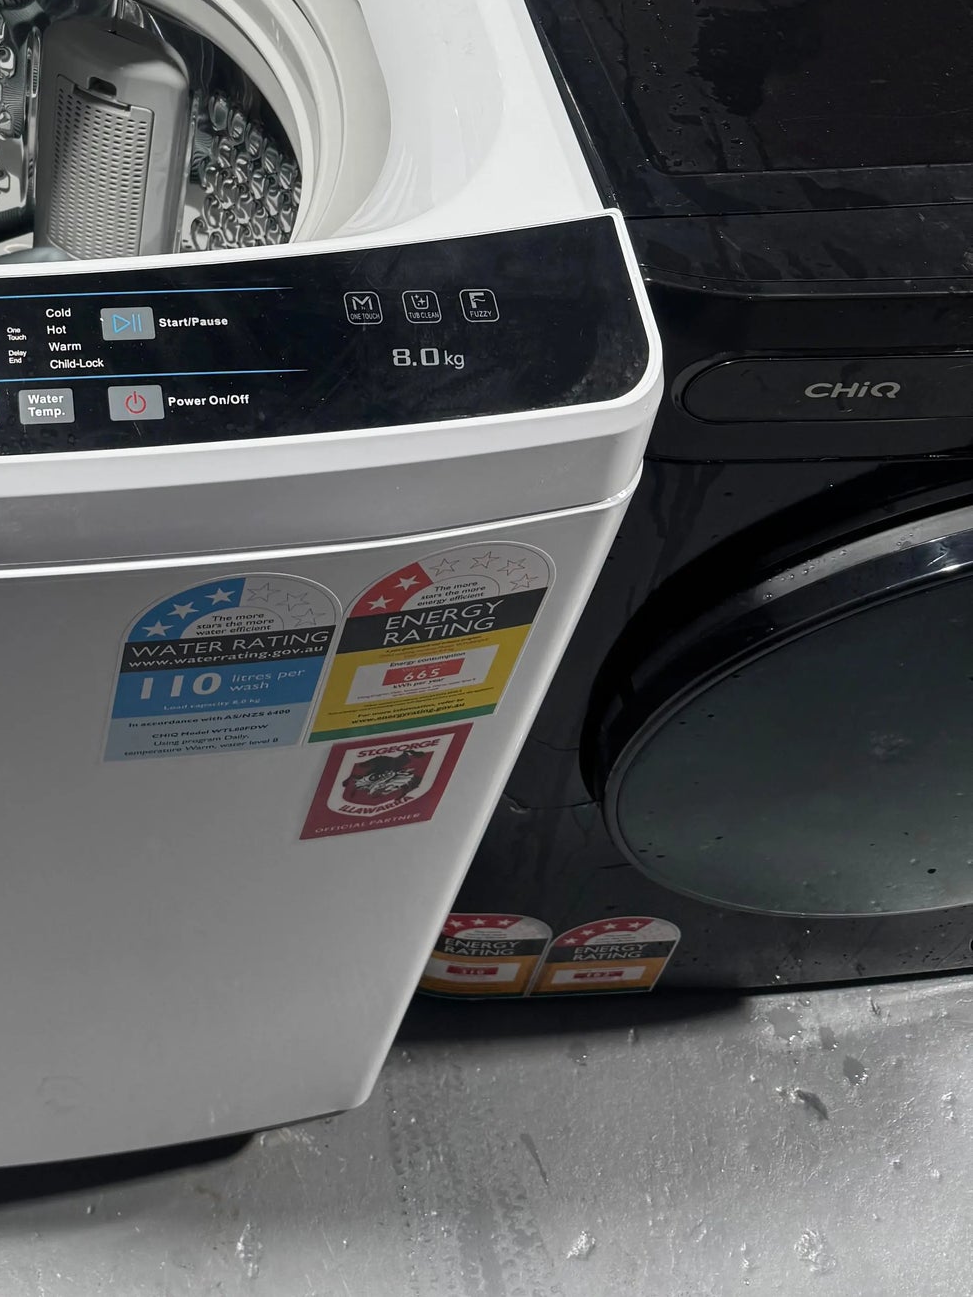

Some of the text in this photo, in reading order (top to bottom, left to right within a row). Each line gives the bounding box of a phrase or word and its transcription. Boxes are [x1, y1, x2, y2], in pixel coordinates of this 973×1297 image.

[46, 309, 71, 318] Cold
[159, 317, 228, 328] Start/Pause
[47, 325, 67, 335] Hot
[49, 343, 81, 351] Warm
[50, 359, 104, 369] Child-Lock
[393, 348, 465, 369] 8.0 kg
[804, 381, 901, 398] CHiQ
[28, 395, 64, 404] Water
[168, 394, 249, 406] Power On/Off
[28, 407, 65, 418] Temp.
[454, 582, 478, 590] more
[421, 592, 442, 600] stars
[462, 586, 486, 594] more
[417, 592, 485, 606] energy efficient
[385, 599, 504, 630] ENERGY
[196, 625, 272, 636] water efficient
[383, 616, 496, 646] RATING
[131, 631, 329, 658] WATER RATING
[129, 645, 324, 668] www.waterrating.gov.au
[389, 656, 416, 667] Energy
[418, 652, 466, 662] consumption
[404, 668, 440, 681] 665
[140, 670, 306, 699] 110 litres per
[229, 682, 269, 691] wash
[223, 711, 264, 720] AS/NZS
[445, 937, 521, 948] ENERGY
[444, 946, 515, 956] RATING
[574, 943, 648, 954] ENERGY
[572, 951, 642, 961] RATING
